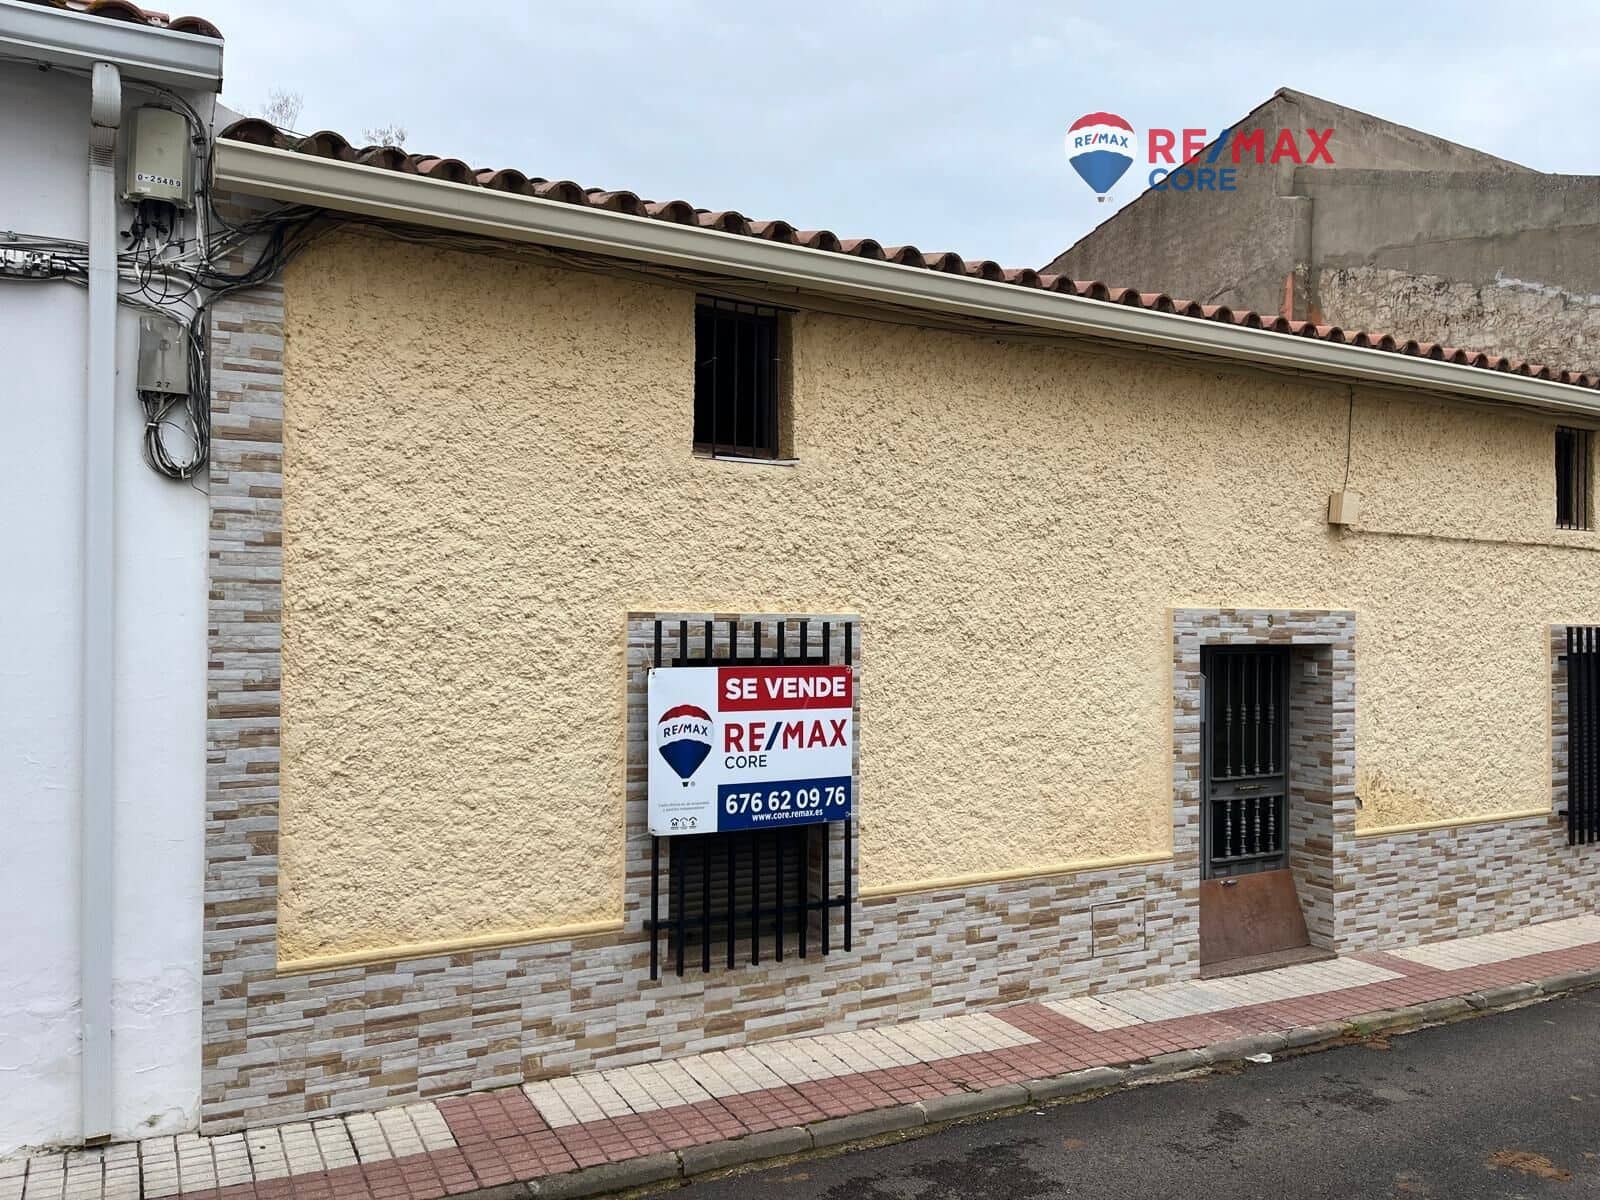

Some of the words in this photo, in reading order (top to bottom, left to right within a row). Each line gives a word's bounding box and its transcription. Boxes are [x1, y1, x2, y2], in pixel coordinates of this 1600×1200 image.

[725, 678, 758, 700] SE
[764, 676, 847, 699] VENDE
[663, 723, 708, 738] RE/MAX
[724, 719, 847, 753] RE/MAX
[725, 755, 768, 769] CORE
[725, 792, 763, 815] 676
[768, 790, 792, 811] 62
[796, 788, 820, 809] 09
[825, 786, 846, 807] 76
[752, 808, 823, 822] www.core.remax.es
